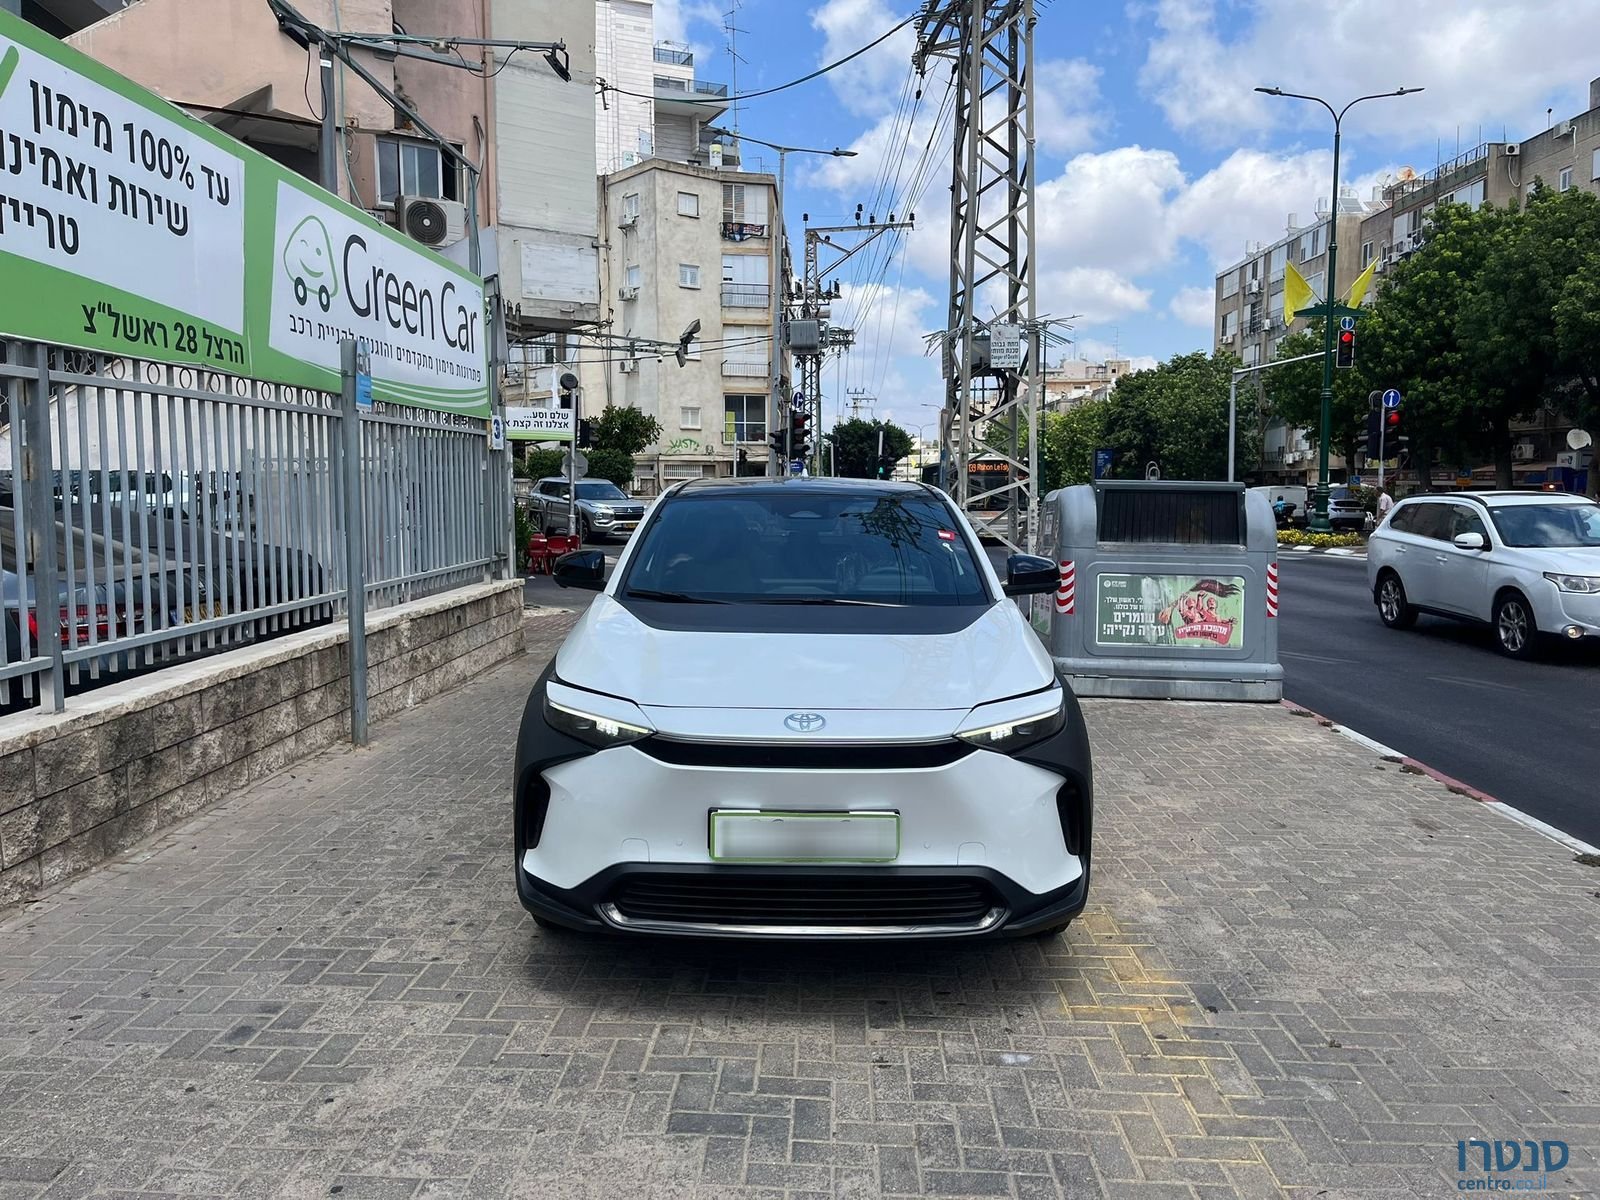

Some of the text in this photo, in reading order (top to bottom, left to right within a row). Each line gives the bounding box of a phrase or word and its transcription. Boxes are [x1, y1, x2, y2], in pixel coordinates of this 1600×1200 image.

[29, 79, 230, 206] עד 100% מימון
[107, 174, 189, 237] שירות
[343, 233, 478, 354] Green Car
[289, 313, 313, 337] רכב
[173, 321, 198, 354] 28
[202, 326, 244, 365] הרצל
[396, 345, 433, 371] מתקדמים
[435, 357, 454, 376] מימון
[455, 363, 481, 383] פתרונות
[512, 420, 531, 430] קצת
[523, 410, 569, 420] שלם וסע...
[536, 420, 543, 428] זה
[545, 419, 569, 429] אצלנו
[493, 418, 501, 440] 3
[1112, 611, 1155, 623] שומרים
[1102, 623, 1136, 637] נקייה!
